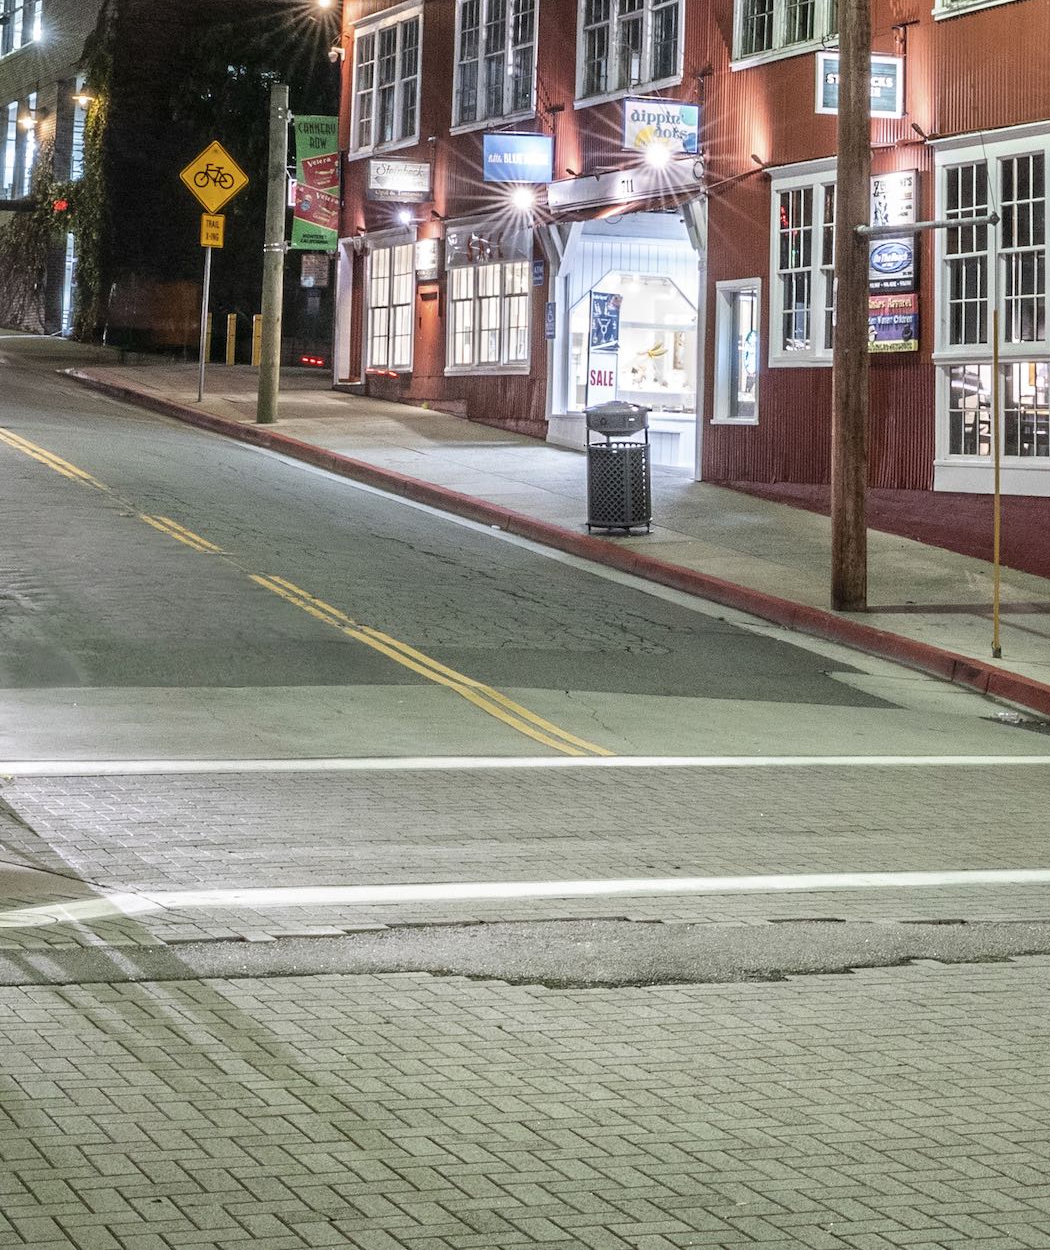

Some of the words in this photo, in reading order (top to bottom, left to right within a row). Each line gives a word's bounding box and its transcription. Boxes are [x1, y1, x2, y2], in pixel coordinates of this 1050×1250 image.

[655, 125, 688, 140] dots
[309, 136, 327, 149] ROW
[590, 369, 614, 387] SALE
